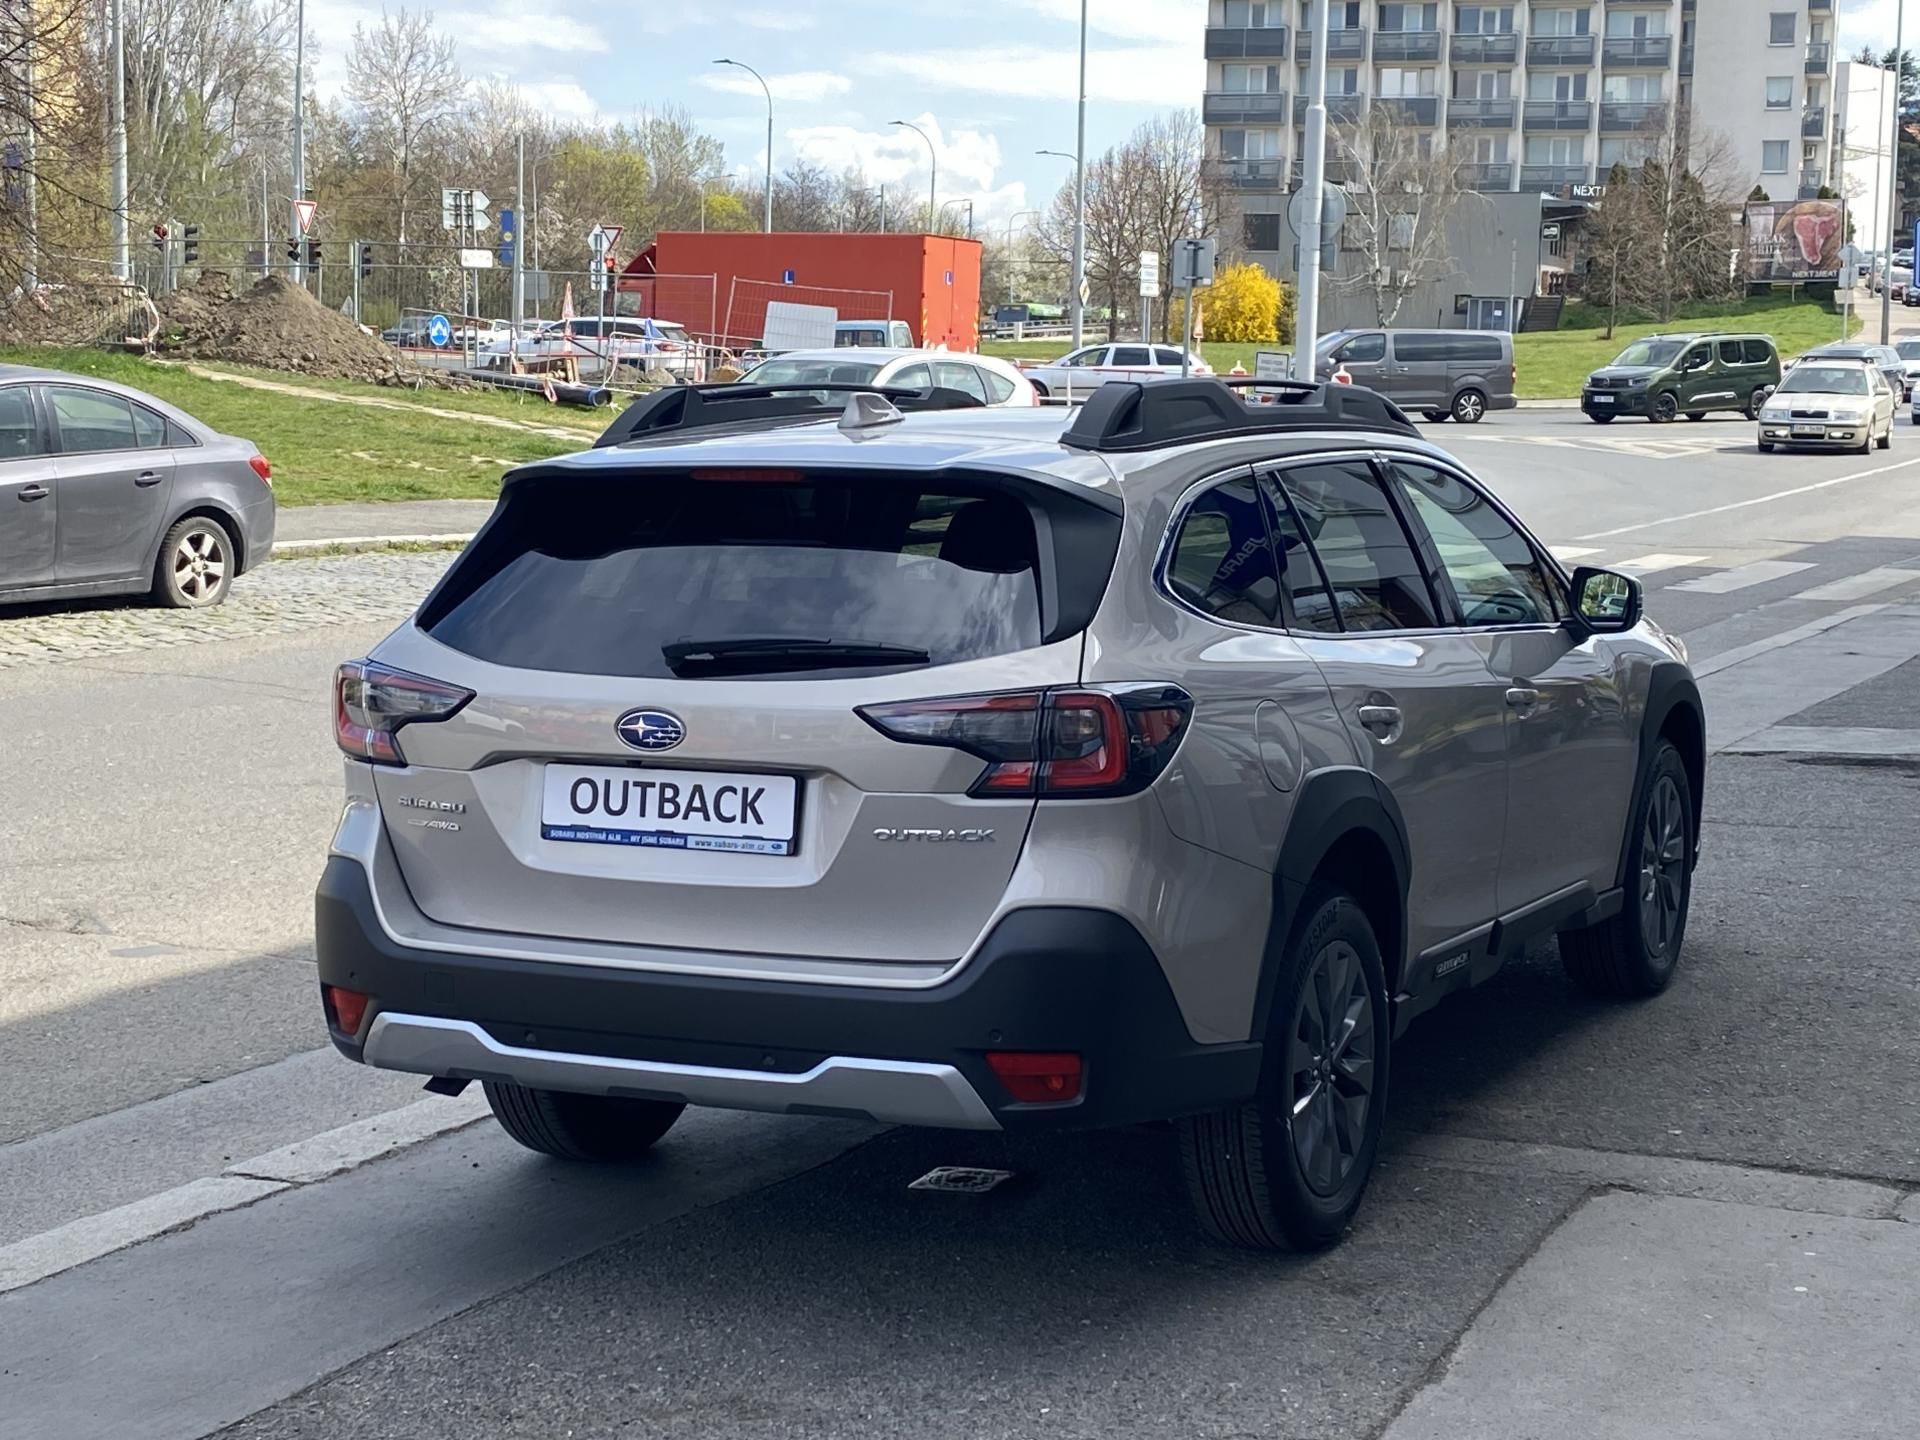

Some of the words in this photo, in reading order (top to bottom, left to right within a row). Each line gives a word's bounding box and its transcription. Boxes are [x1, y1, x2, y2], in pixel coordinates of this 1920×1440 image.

[1749, 233, 1786, 244] STEAK
[398, 796, 466, 814] SUBARU
[570, 777, 766, 825] OUTBACK
[873, 828, 996, 842] OUTBACK
